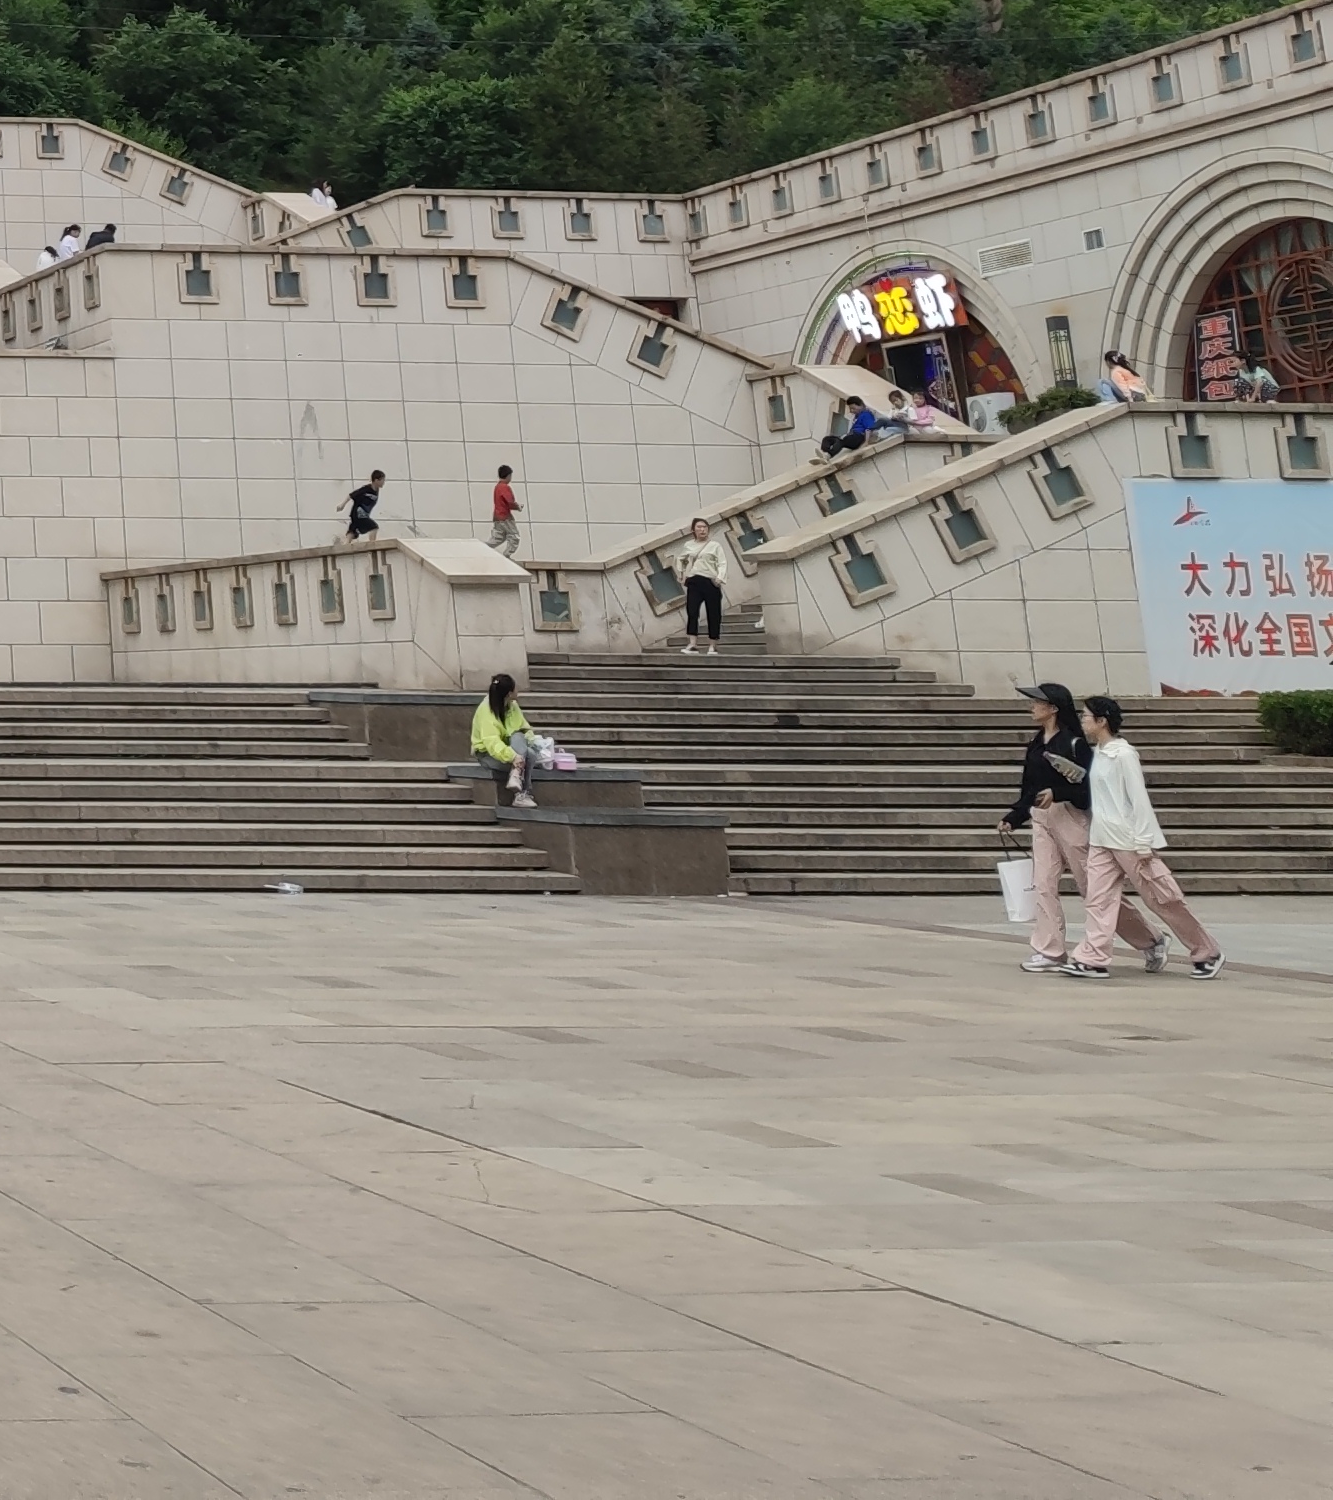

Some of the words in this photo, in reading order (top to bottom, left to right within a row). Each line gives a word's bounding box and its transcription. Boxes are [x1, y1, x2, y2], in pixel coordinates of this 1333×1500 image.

[836, 274, 954, 343] 鸭恋虾
[1198, 315, 1238, 401] 重庆纸包
[1180, 551, 1333, 597] 大力弘扬
